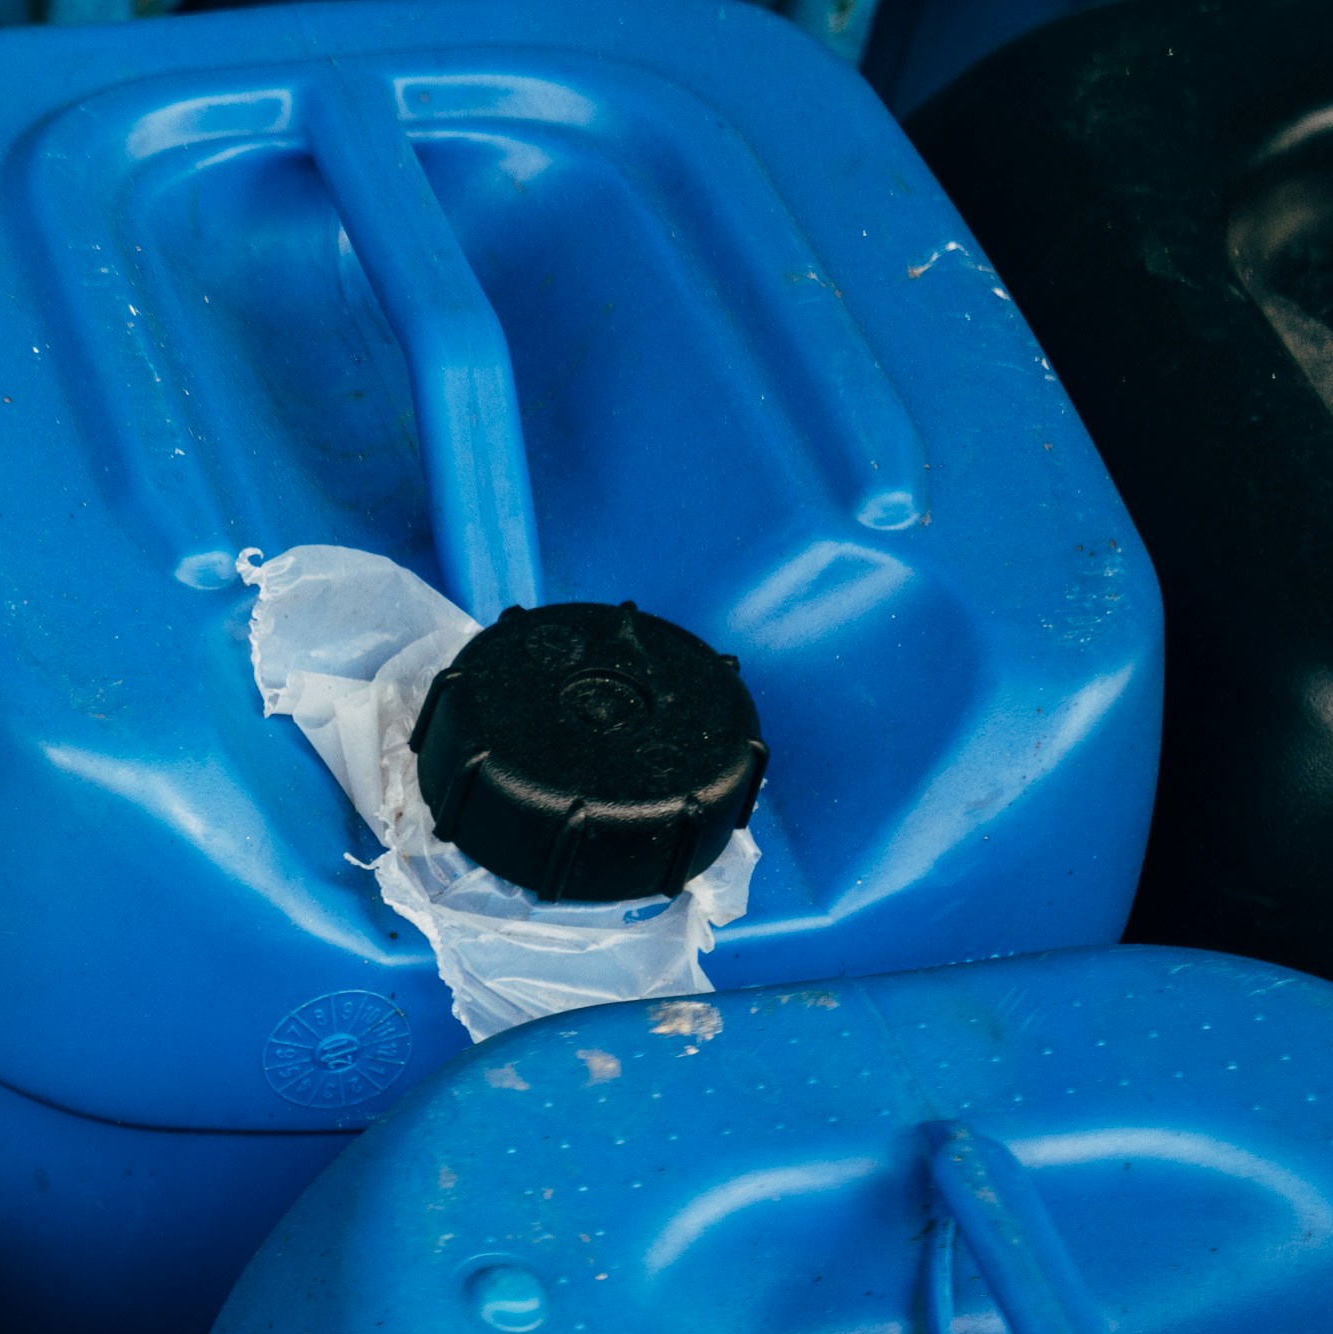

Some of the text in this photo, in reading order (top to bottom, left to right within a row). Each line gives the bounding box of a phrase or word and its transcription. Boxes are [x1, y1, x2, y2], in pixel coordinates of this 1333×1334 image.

[313, 1008, 328, 1026] 8
[340, 1001, 354, 1020] 9
[360, 1005, 381, 1024] 10
[285, 1024, 303, 1038] 7
[372, 1020, 397, 1038] 11
[275, 1047, 297, 1059] 6
[376, 1042, 398, 1057] 12
[278, 1066, 300, 1078] 5
[323, 1082, 335, 1099] 3
[347, 1076, 363, 1093] 2
